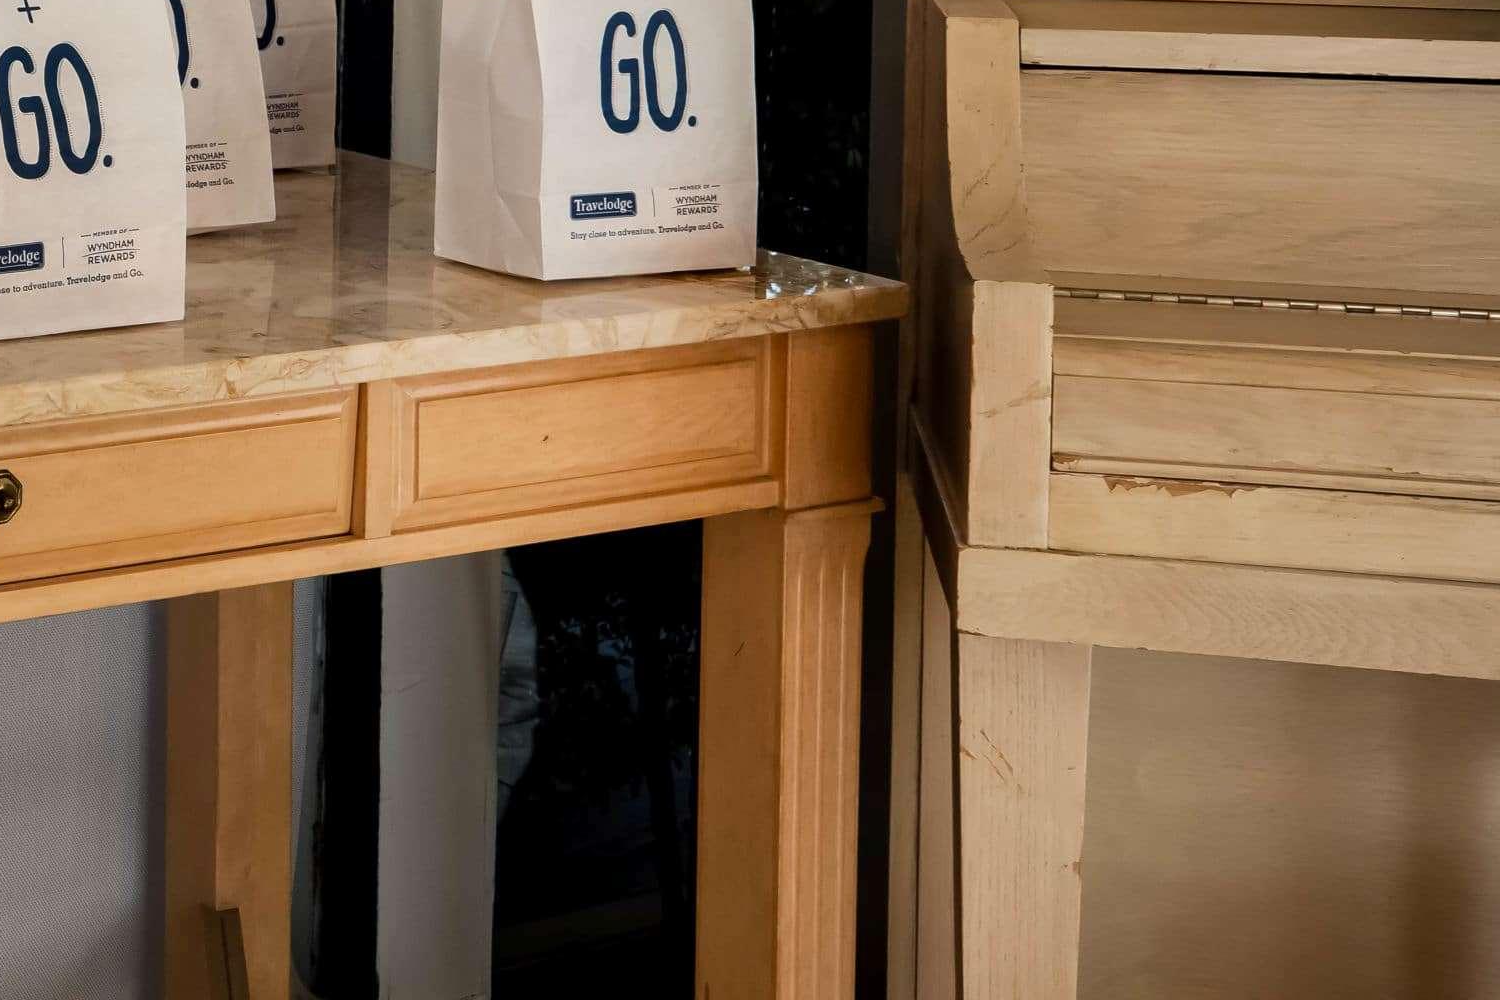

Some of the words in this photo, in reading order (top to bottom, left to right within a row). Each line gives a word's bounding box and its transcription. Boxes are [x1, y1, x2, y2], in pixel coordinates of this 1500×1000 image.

[600, 9, 698, 134] GO.
[186, 162, 227, 173] REWARDS
[209, 178, 222, 186] and
[573, 197, 634, 213] Travelodge
[675, 194, 717, 204] WYNDHAM
[676, 206, 718, 216] REWARDS
[92, 229, 118, 237] MEMBER
[570, 231, 587, 240] Stay
[588, 230, 607, 239] close
[698, 222, 712, 231] and
[87, 238, 135, 253] WYNDHAM
[87, 251, 136, 265] REWARDS
[12, 284, 21, 293] to
[22, 279, 65, 292] adventure.
[66, 274, 111, 286] Travelodge
[112, 270, 128, 280] and
[129, 269, 144, 278] Go.
